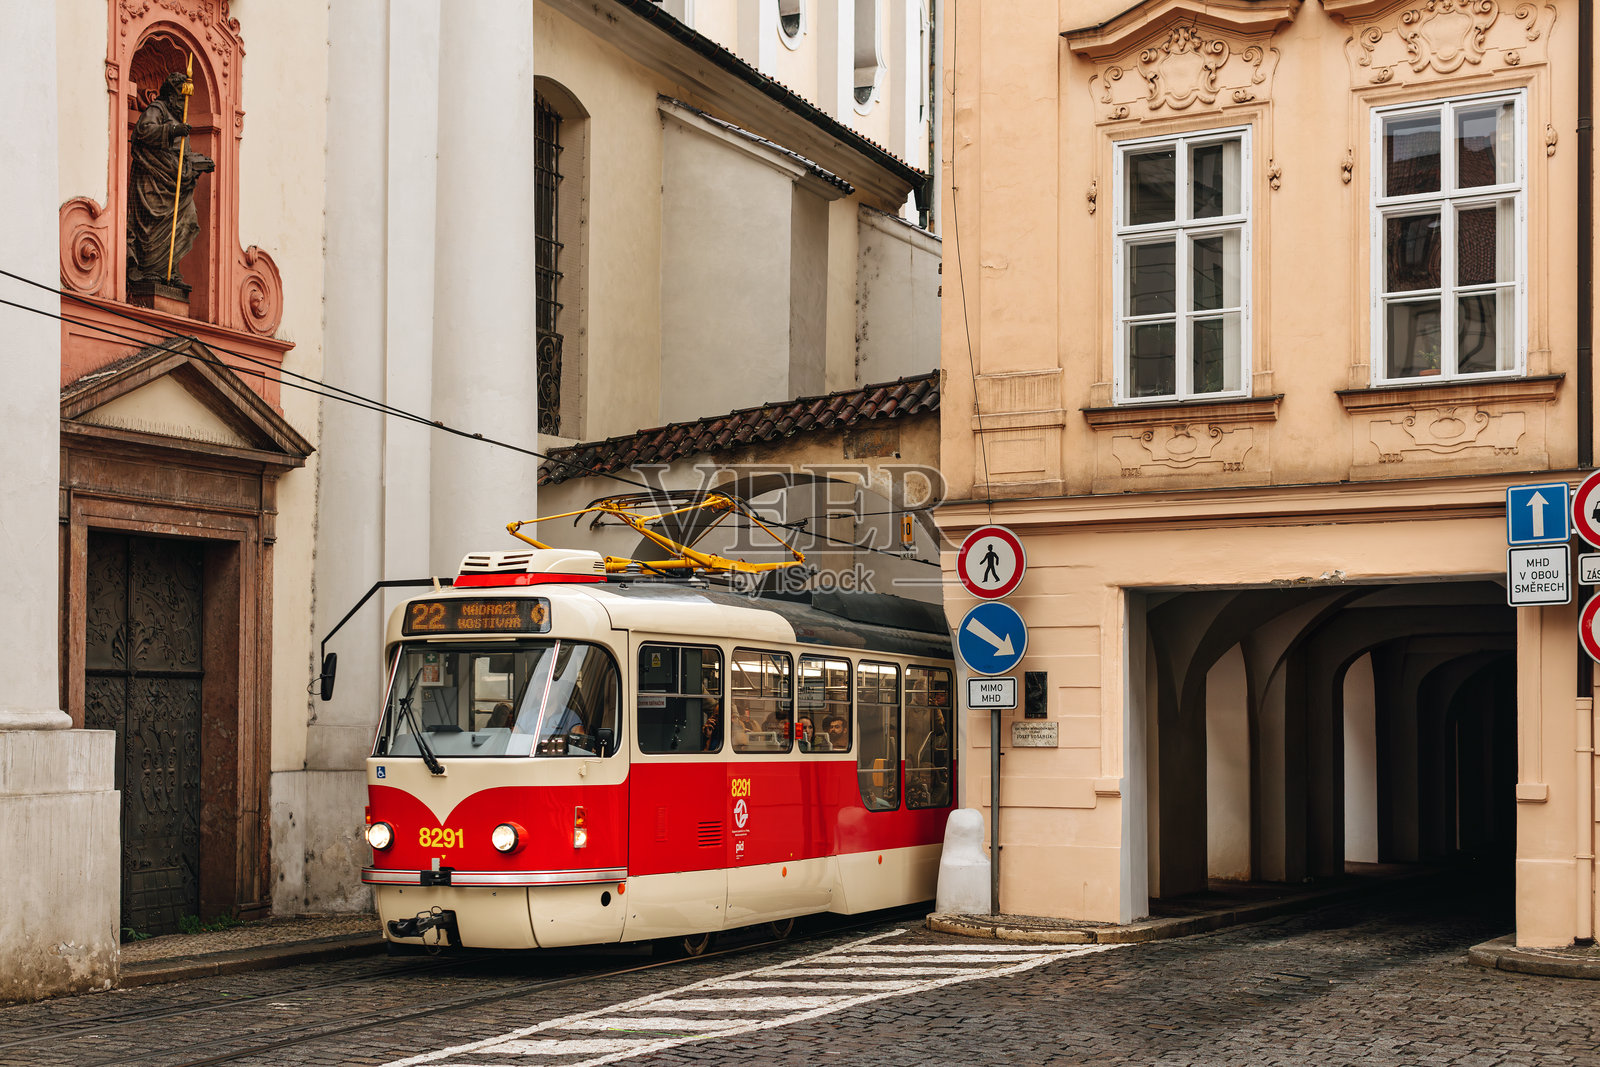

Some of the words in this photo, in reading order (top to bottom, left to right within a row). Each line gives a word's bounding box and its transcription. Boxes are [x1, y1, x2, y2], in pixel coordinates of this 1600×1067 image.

[1526, 558, 1550, 568] MHD
[1519, 572, 1526, 580] V
[1531, 570, 1559, 580] OBOU
[1515, 581, 1564, 593] SMĚRECH
[411, 602, 446, 630] 22
[980, 684, 1003, 692] MIMO
[731, 778, 751, 797] 8291
[418, 827, 464, 848] 8291
